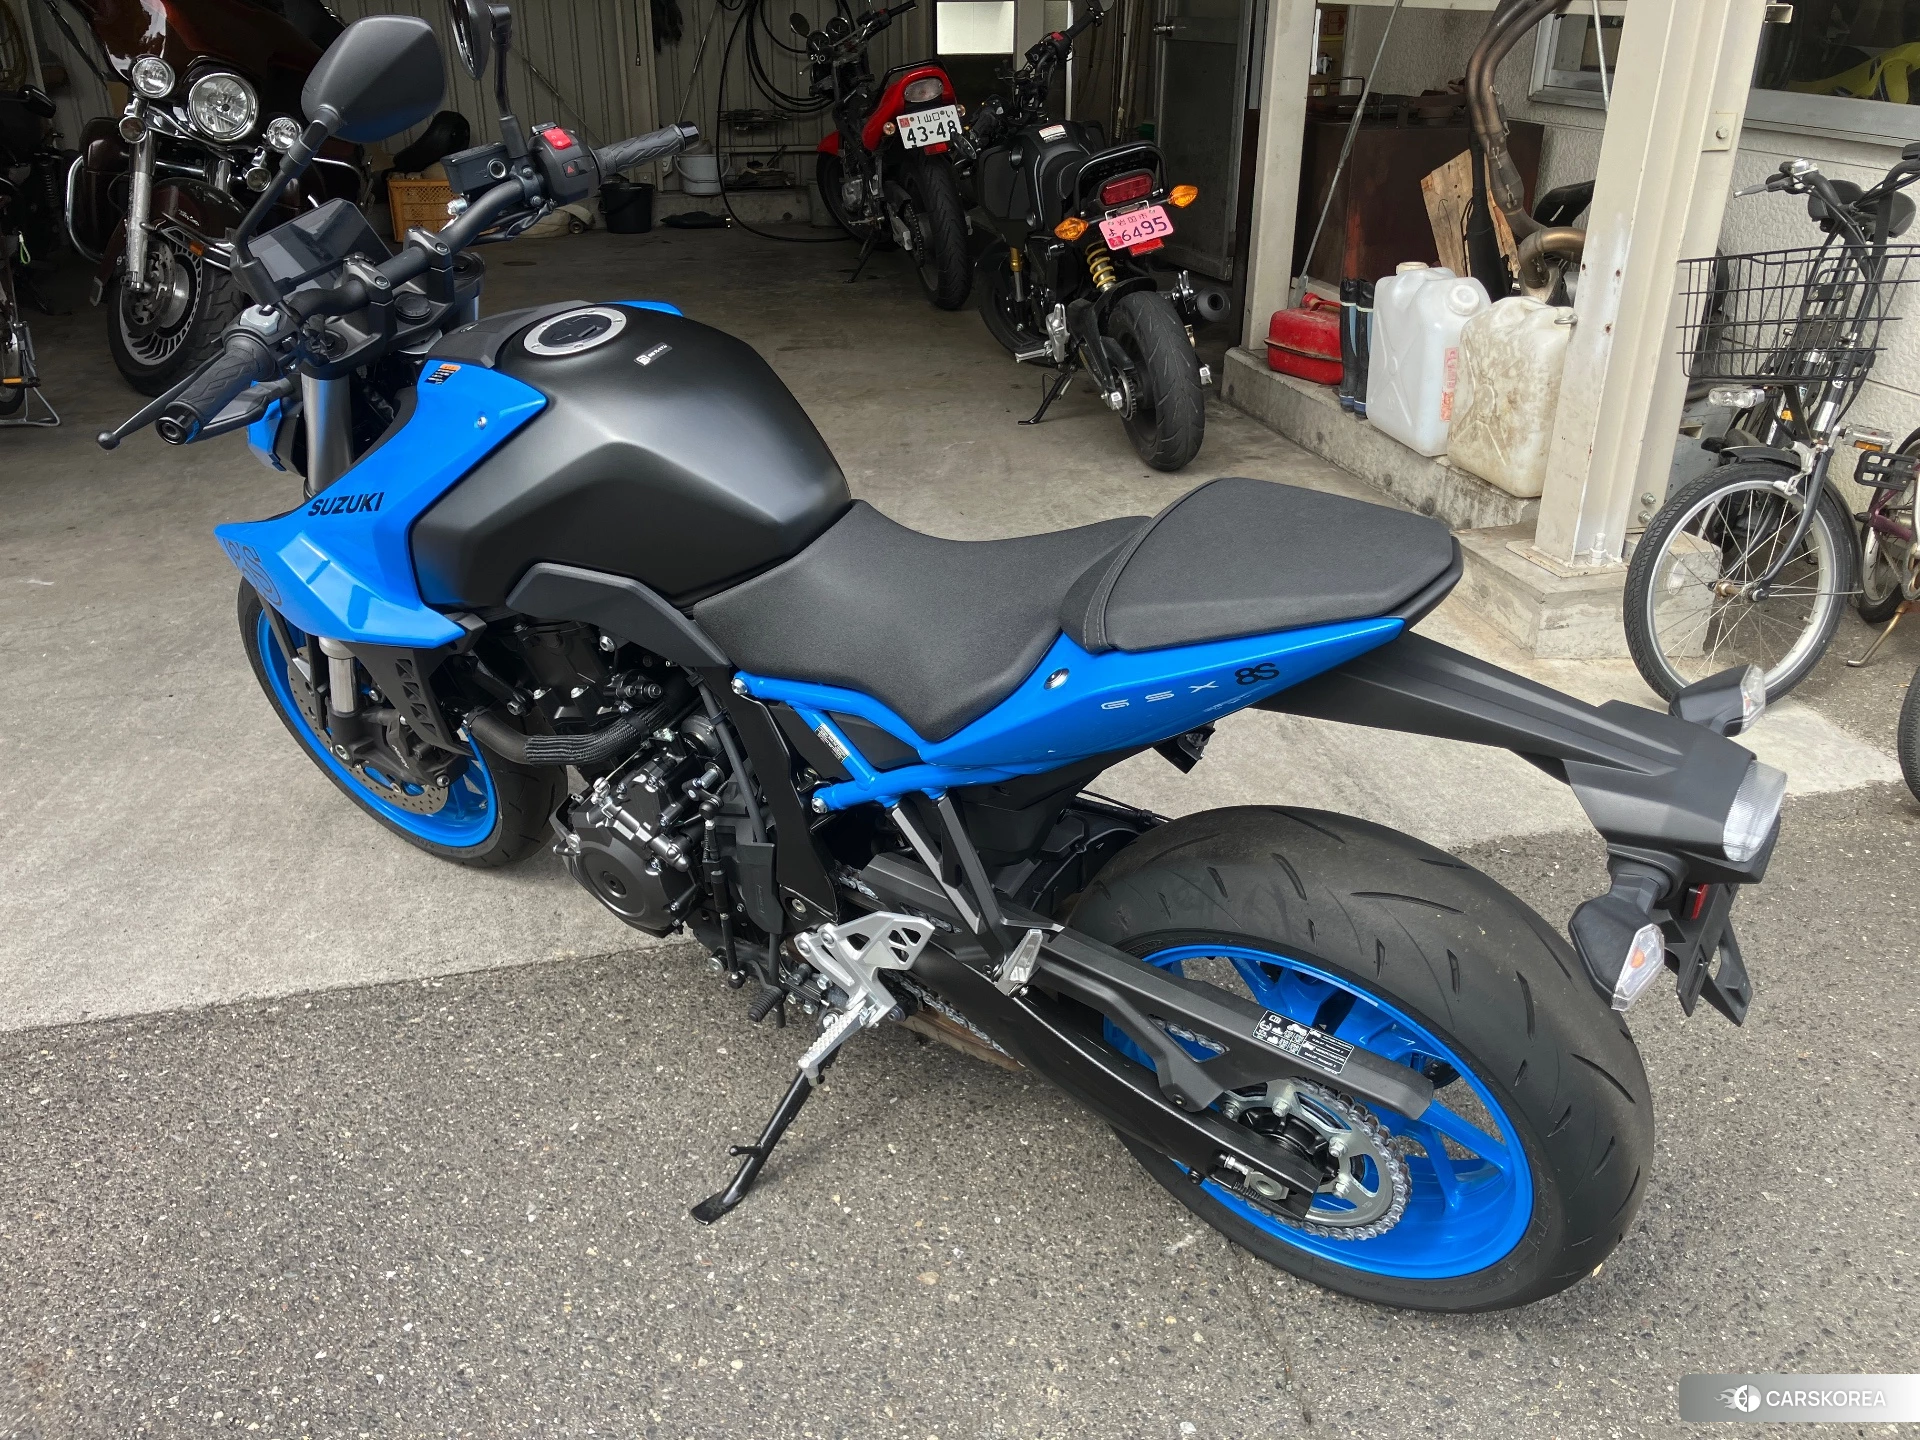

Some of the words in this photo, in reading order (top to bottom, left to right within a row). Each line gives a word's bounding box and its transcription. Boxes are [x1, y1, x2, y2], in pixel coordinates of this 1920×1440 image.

[906, 120, 958, 144] 43-48
[1121, 216, 1168, 241] 6495
[308, 492, 385, 516] SUZUKI
[1234, 662, 1280, 686] 8S
